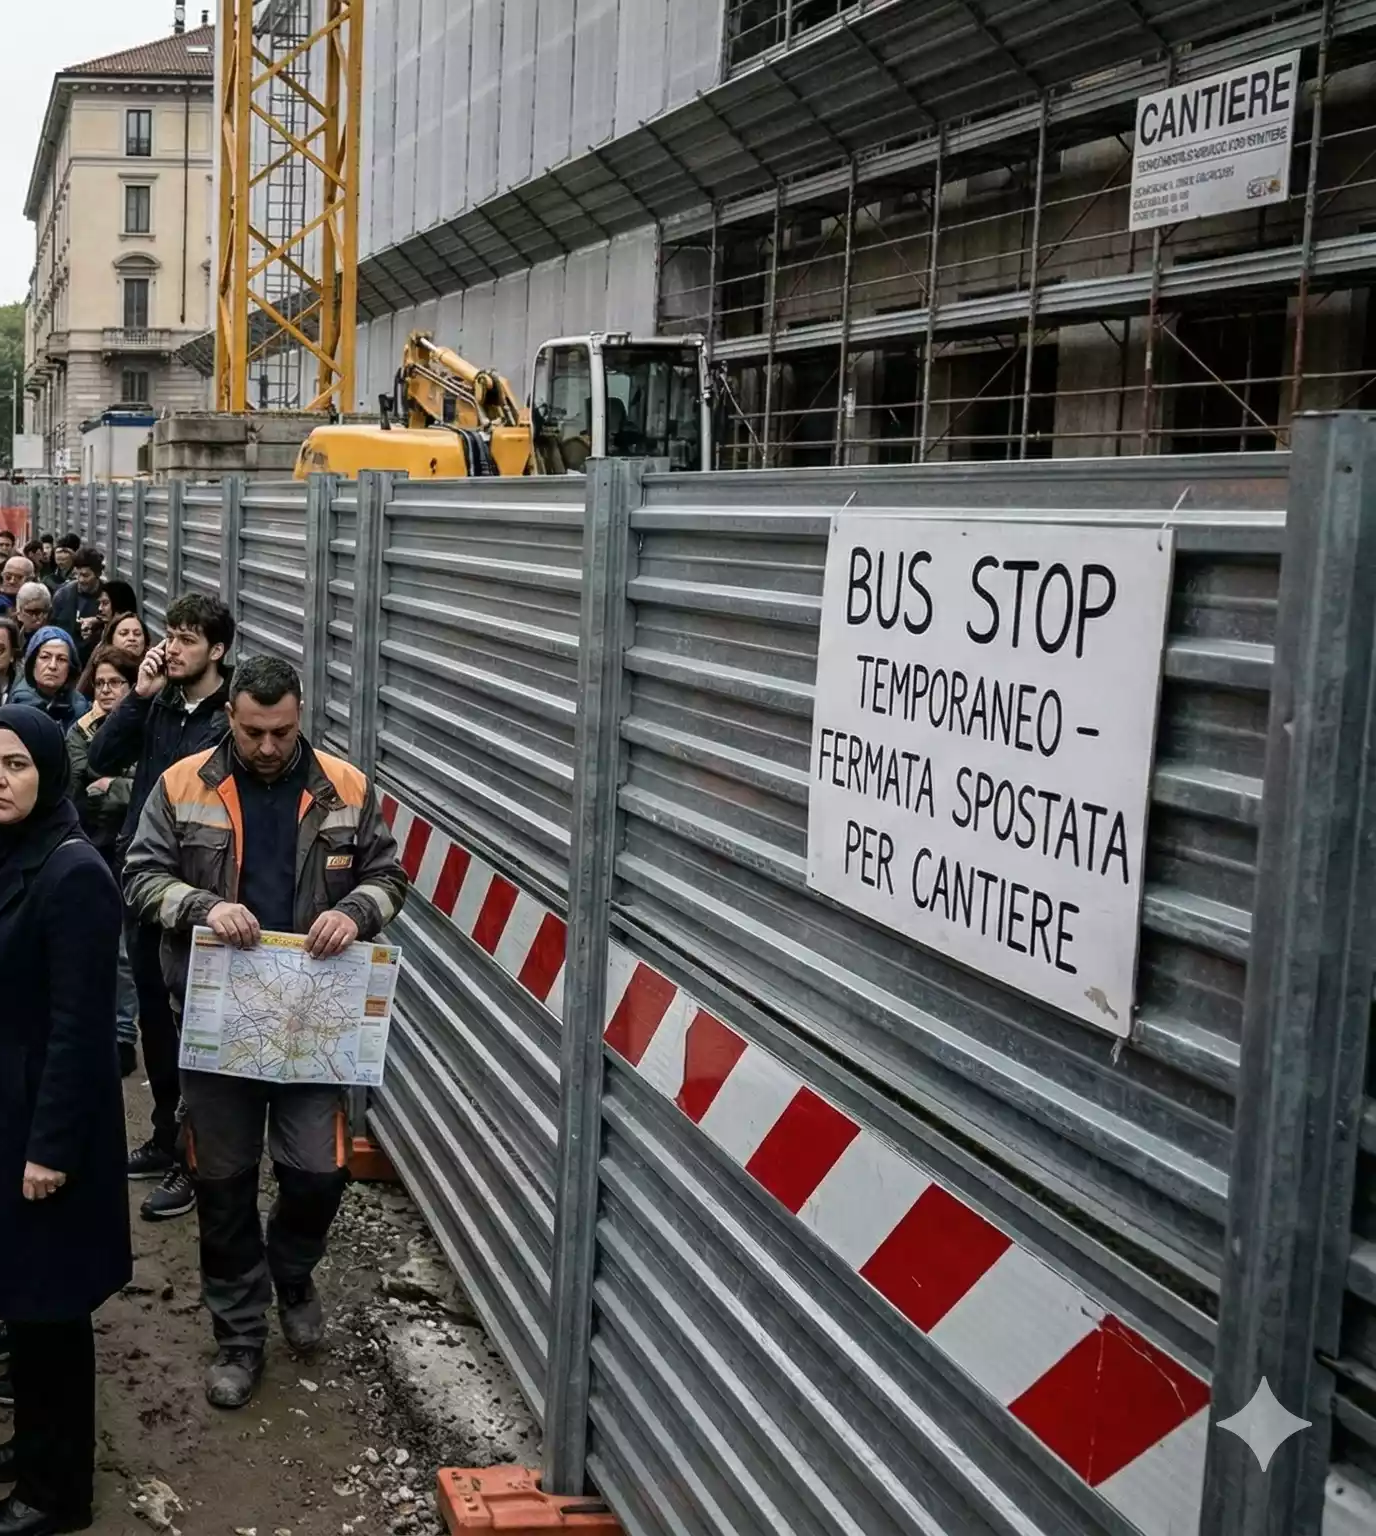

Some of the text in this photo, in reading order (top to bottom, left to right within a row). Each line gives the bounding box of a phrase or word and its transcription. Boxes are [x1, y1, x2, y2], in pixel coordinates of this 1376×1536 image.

[1140, 62, 1293, 146] CANTIERE
[846, 546, 1117, 659] BUS STOP
[818, 728, 1130, 885] FERMATA SPOSTATA
[844, 819, 1080, 975] PER CANTIERE
